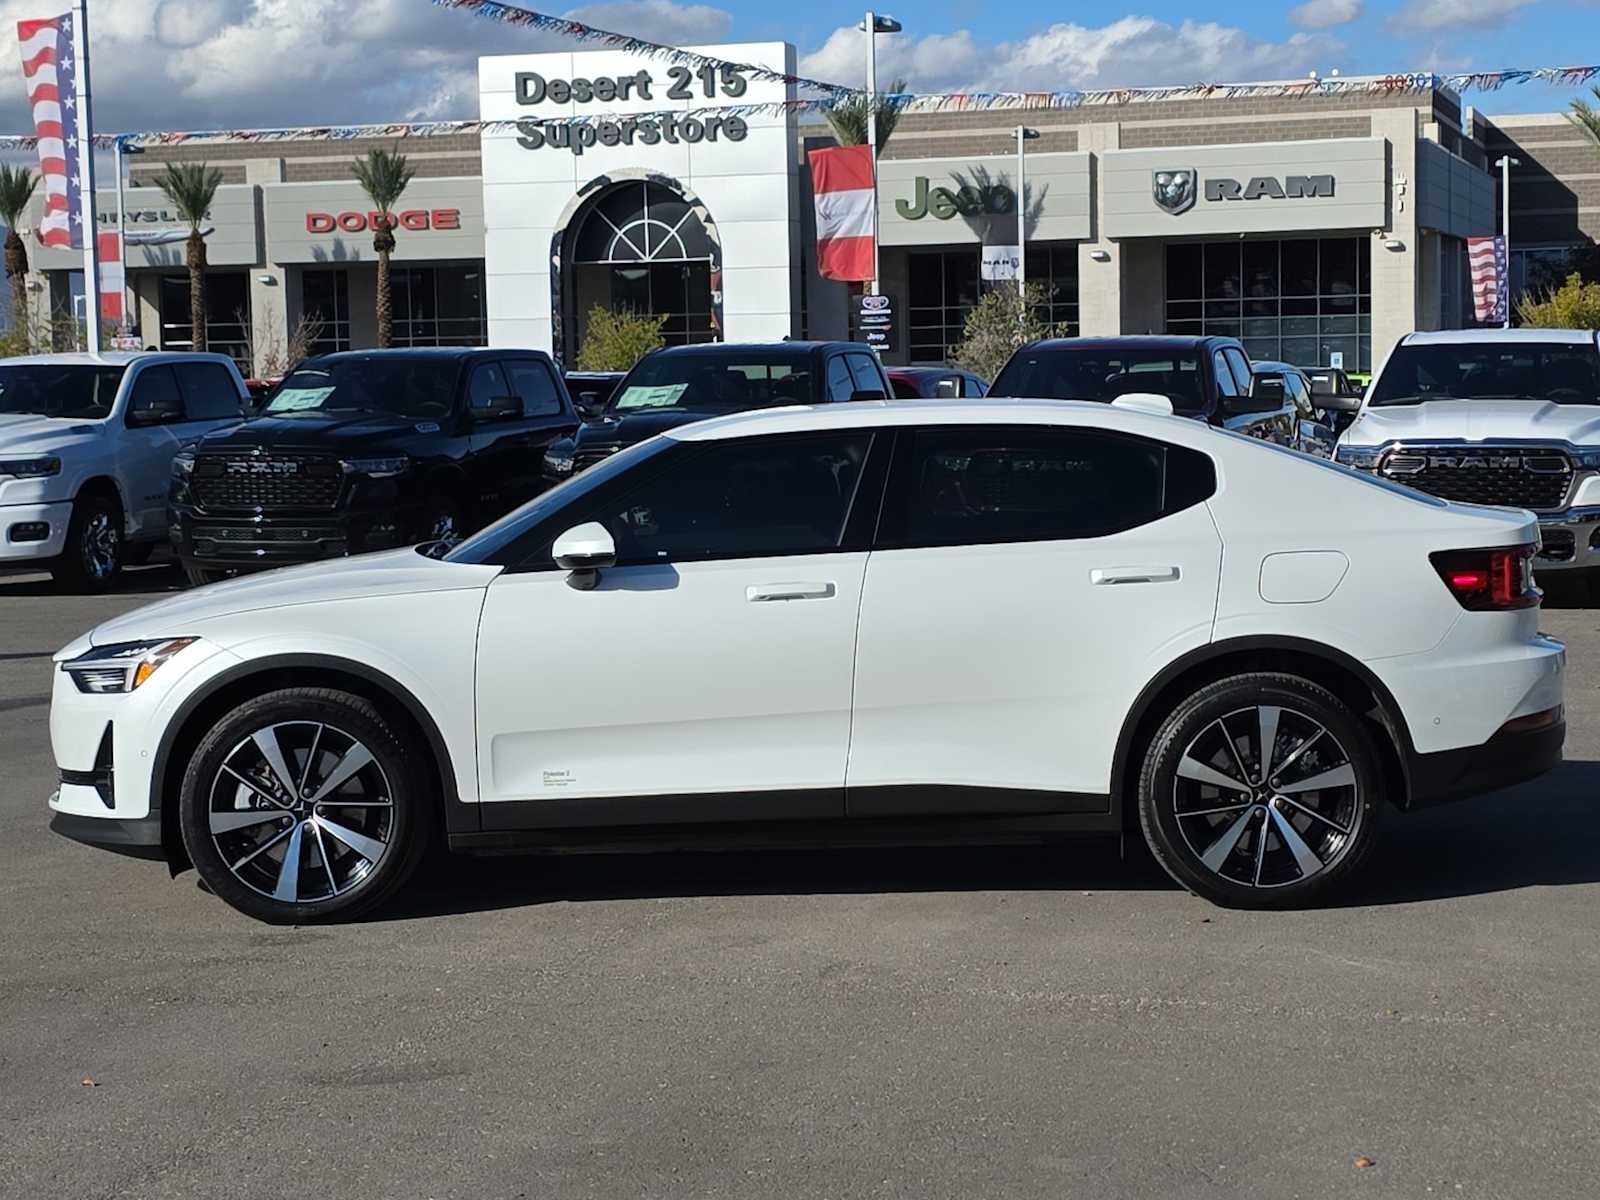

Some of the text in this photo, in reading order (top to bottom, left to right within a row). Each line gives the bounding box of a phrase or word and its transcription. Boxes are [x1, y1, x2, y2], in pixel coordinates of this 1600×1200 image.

[515, 65, 747, 105] Desert 215
[516, 115, 748, 156] Superstore
[1204, 174, 1335, 202] RAM
[306, 208, 461, 234] DODGE
[226, 461, 298, 474] RAM
[1429, 455, 1520, 469] RAM
